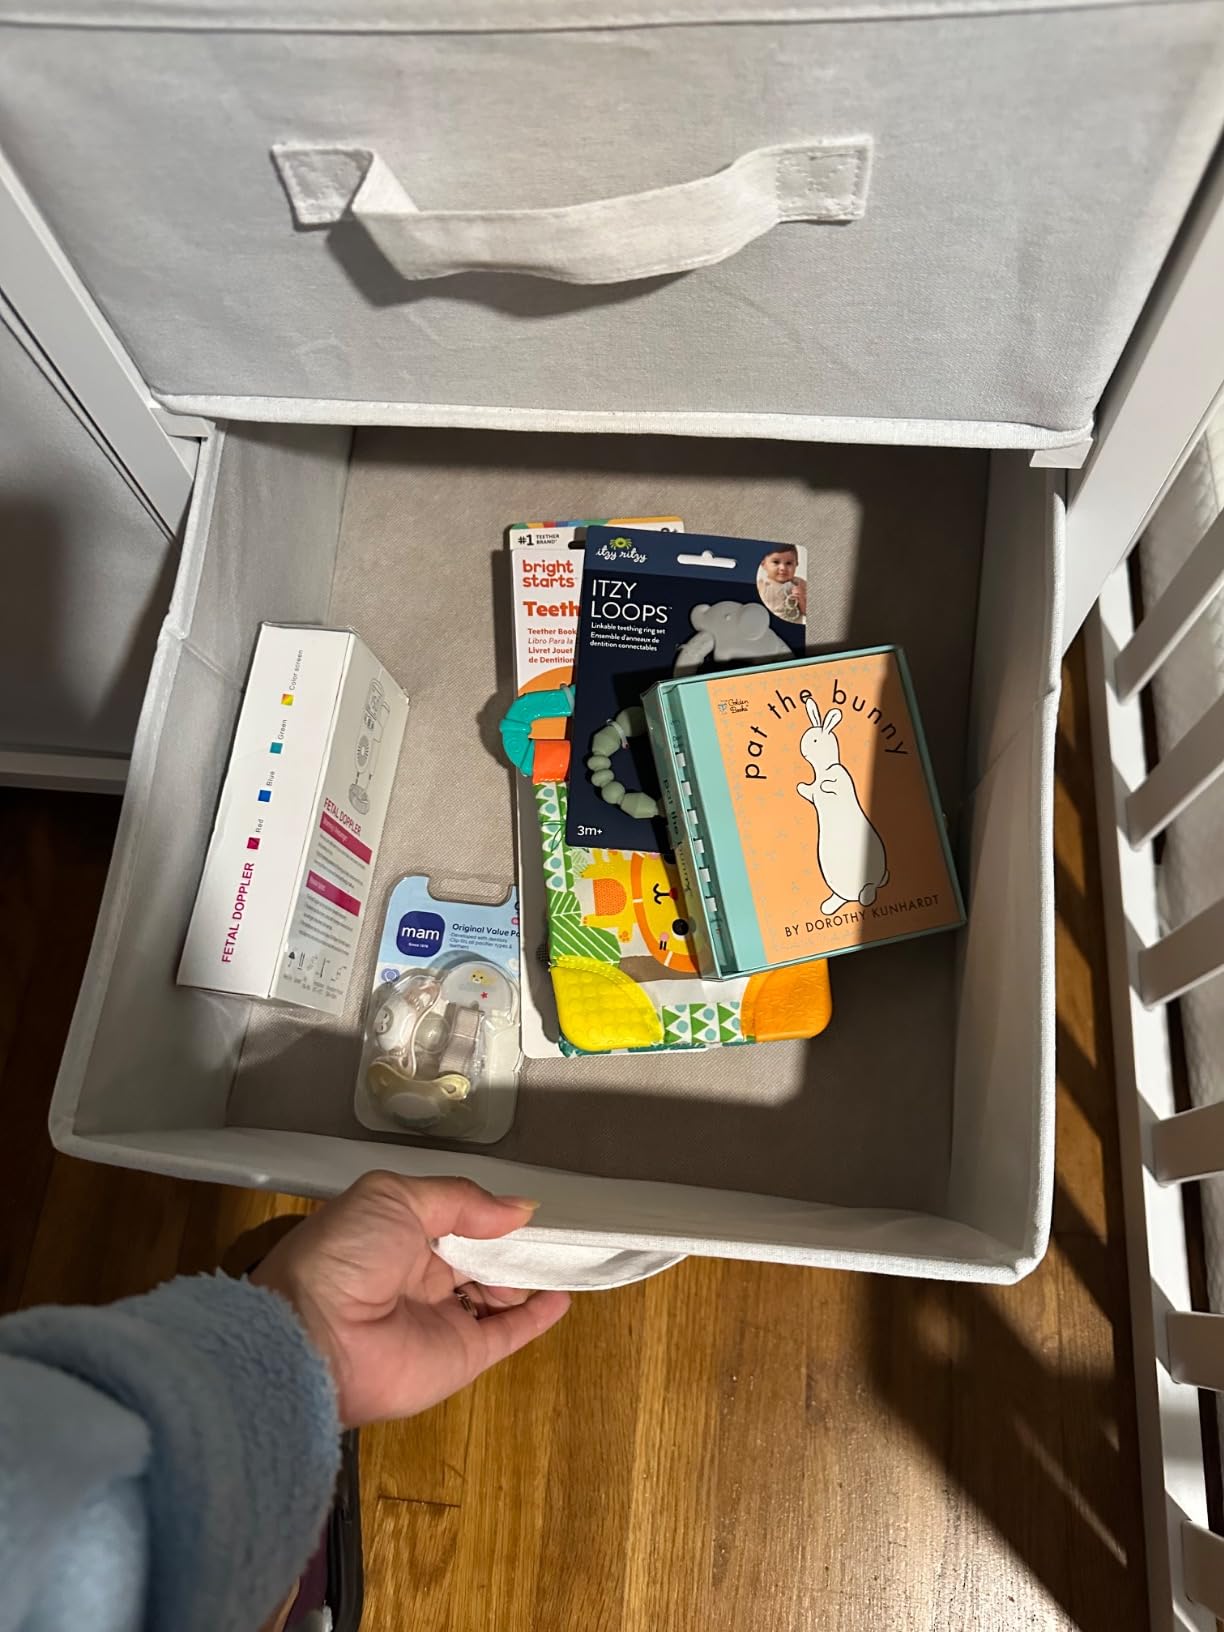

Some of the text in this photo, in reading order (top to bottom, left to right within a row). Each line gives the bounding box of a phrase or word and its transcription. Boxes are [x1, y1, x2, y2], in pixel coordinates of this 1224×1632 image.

[517, 534, 535, 546] #1
[595, 544, 648, 564] itzy ritzy
[522, 559, 574, 577] bright
[522, 574, 575, 588] starts
[592, 579, 637, 600] ITZY
[591, 621, 617, 630] Linkable
[617, 624, 643, 635] teething
[643, 626, 656, 636] ring
[527, 637, 548, 645] Libro
[590, 631, 621, 641] Ensemble
[621, 634, 651, 643] d'anneaux
[589, 639, 658, 652] dentition connectables
[540, 656, 577, 664] Dentition
[288, 649, 304, 691] Color screen
[277, 719, 287, 740] Green
[745, 725, 768, 780] pat
[767, 688, 812, 720] the
[832, 678, 909, 755] bunny
[265, 770, 276, 787] Blue
[323, 797, 339, 819] FETAL
[339, 812, 362, 834] DOPPLER
[255, 818, 264, 833] Red
[577, 824, 603, 836] 3m+
[221, 862, 255, 963] FETAL DOPPLER
[784, 894, 940, 938] BY DOROTHY KUNHARDT
[401, 926, 440, 941] mam
[452, 922, 485, 933] Original
[486, 926, 509, 937] Value
